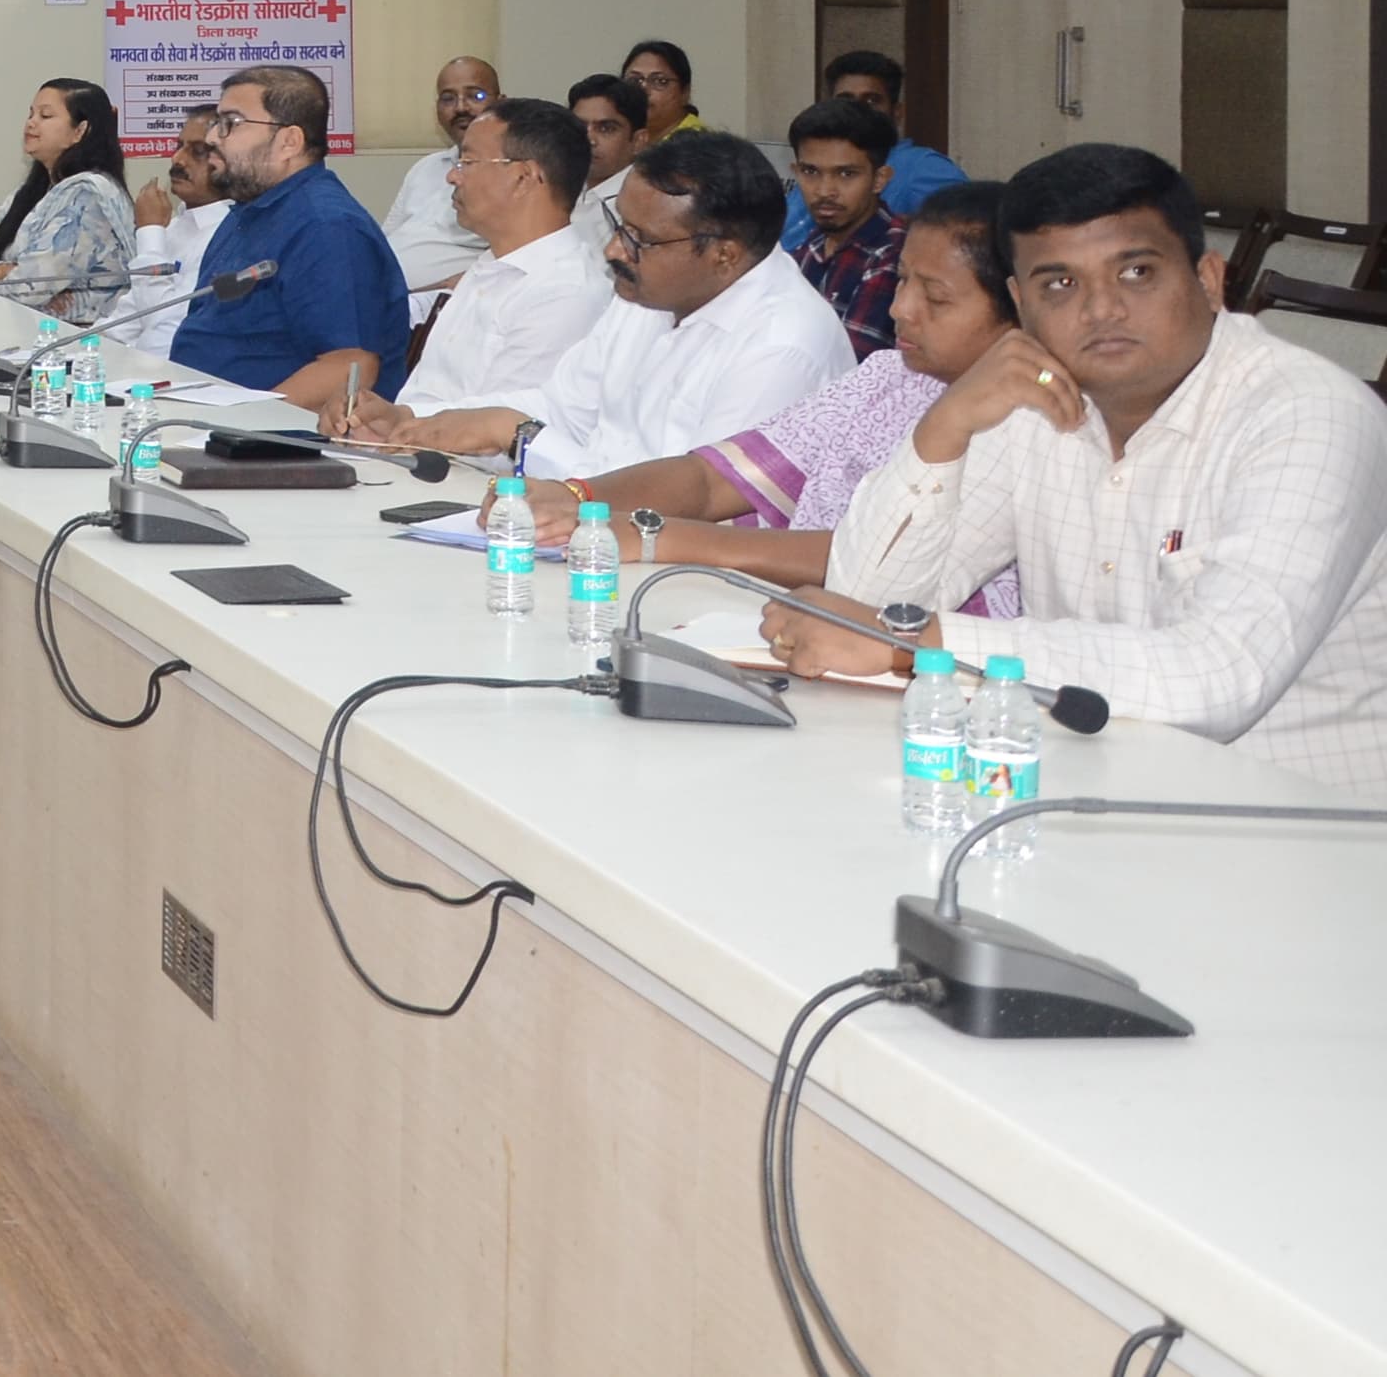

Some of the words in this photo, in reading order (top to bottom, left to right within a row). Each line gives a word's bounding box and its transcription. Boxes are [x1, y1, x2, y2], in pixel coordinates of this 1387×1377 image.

[197, 25, 224, 38] जिला
[227, 27, 259, 40] रायपुर
[110, 47, 148, 62] मानवता
[150, 42, 165, 62] की
[168, 42, 187, 62] सेवा
[189, 42, 198, 62] में
[200, 42, 236, 62] रेडक्रॉस
[238, 40, 280, 61] सोसायटी
[282, 45, 297, 61] का
[299, 45, 327, 60] सदस्य
[330, 40, 346, 60] बने
